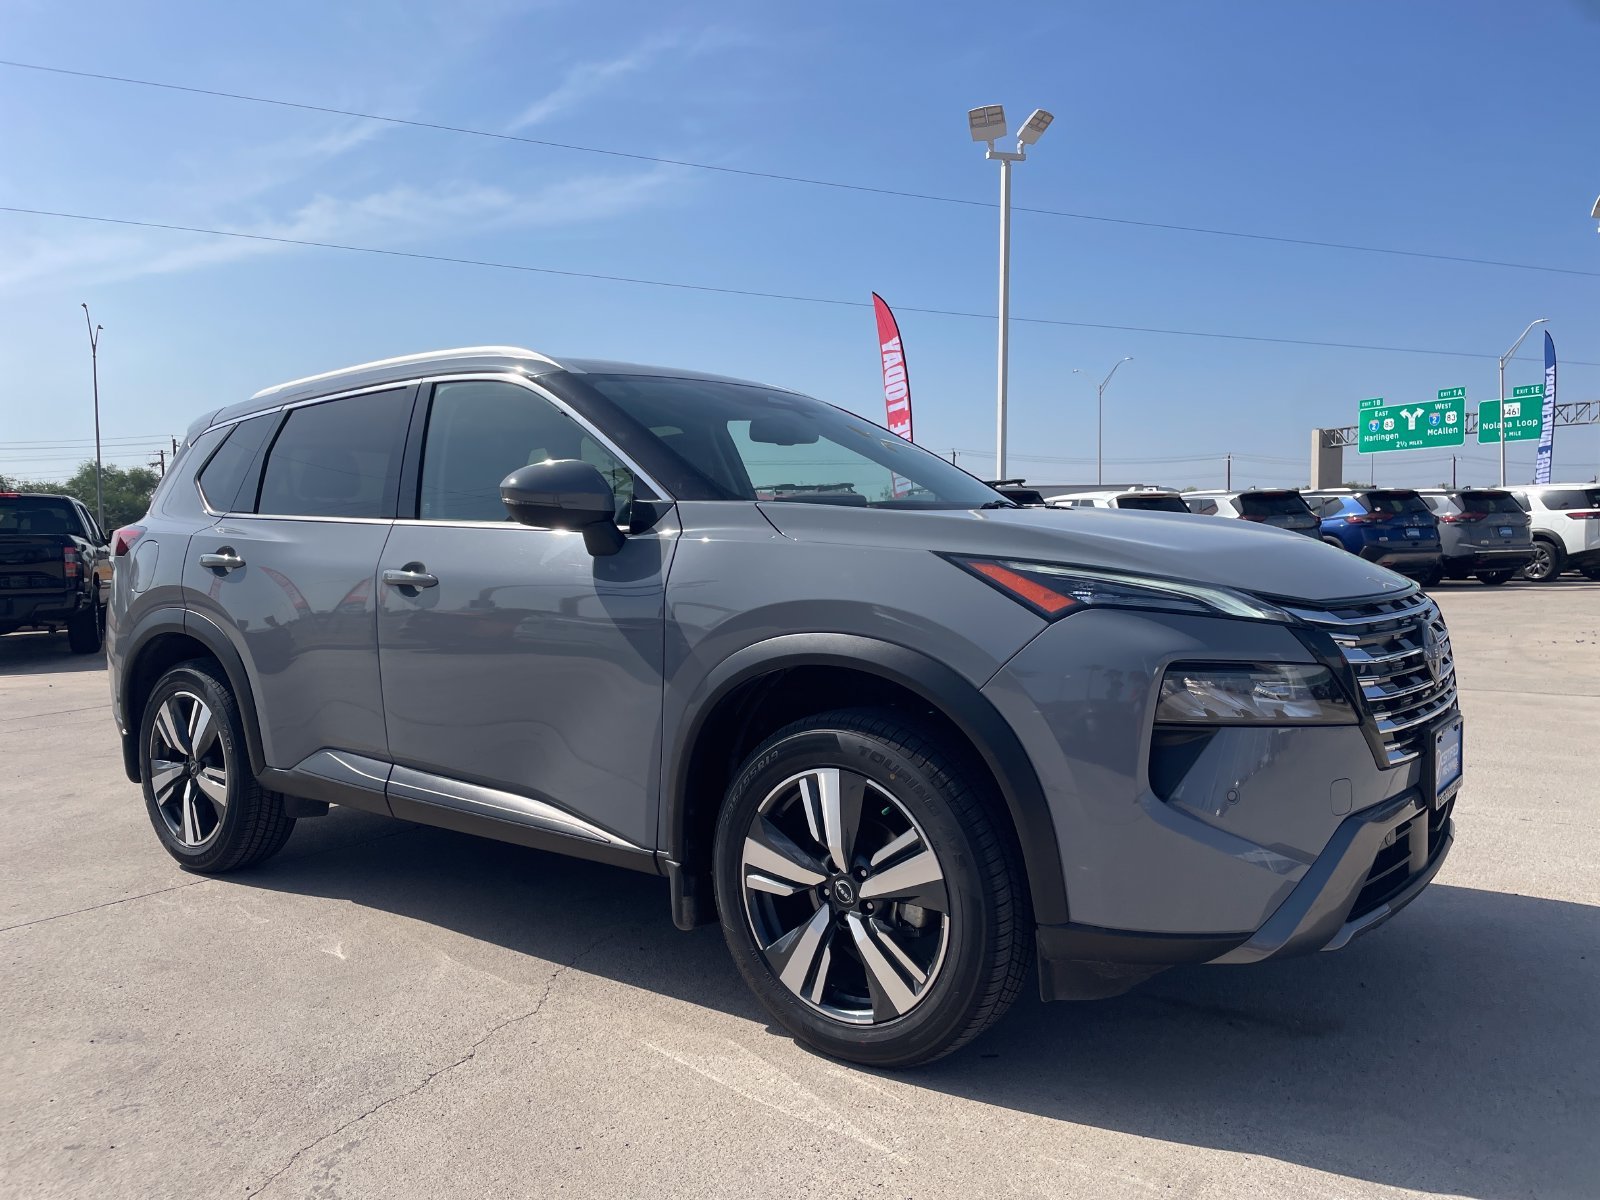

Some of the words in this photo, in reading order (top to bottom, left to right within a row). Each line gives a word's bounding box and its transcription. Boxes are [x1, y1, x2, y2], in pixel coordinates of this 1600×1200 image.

[1530, 385, 1540, 394] 1E
[1516, 419, 1538, 428] Loop
[1427, 427, 1458, 436] McAllen
[1364, 433, 1399, 442] Harlingen
